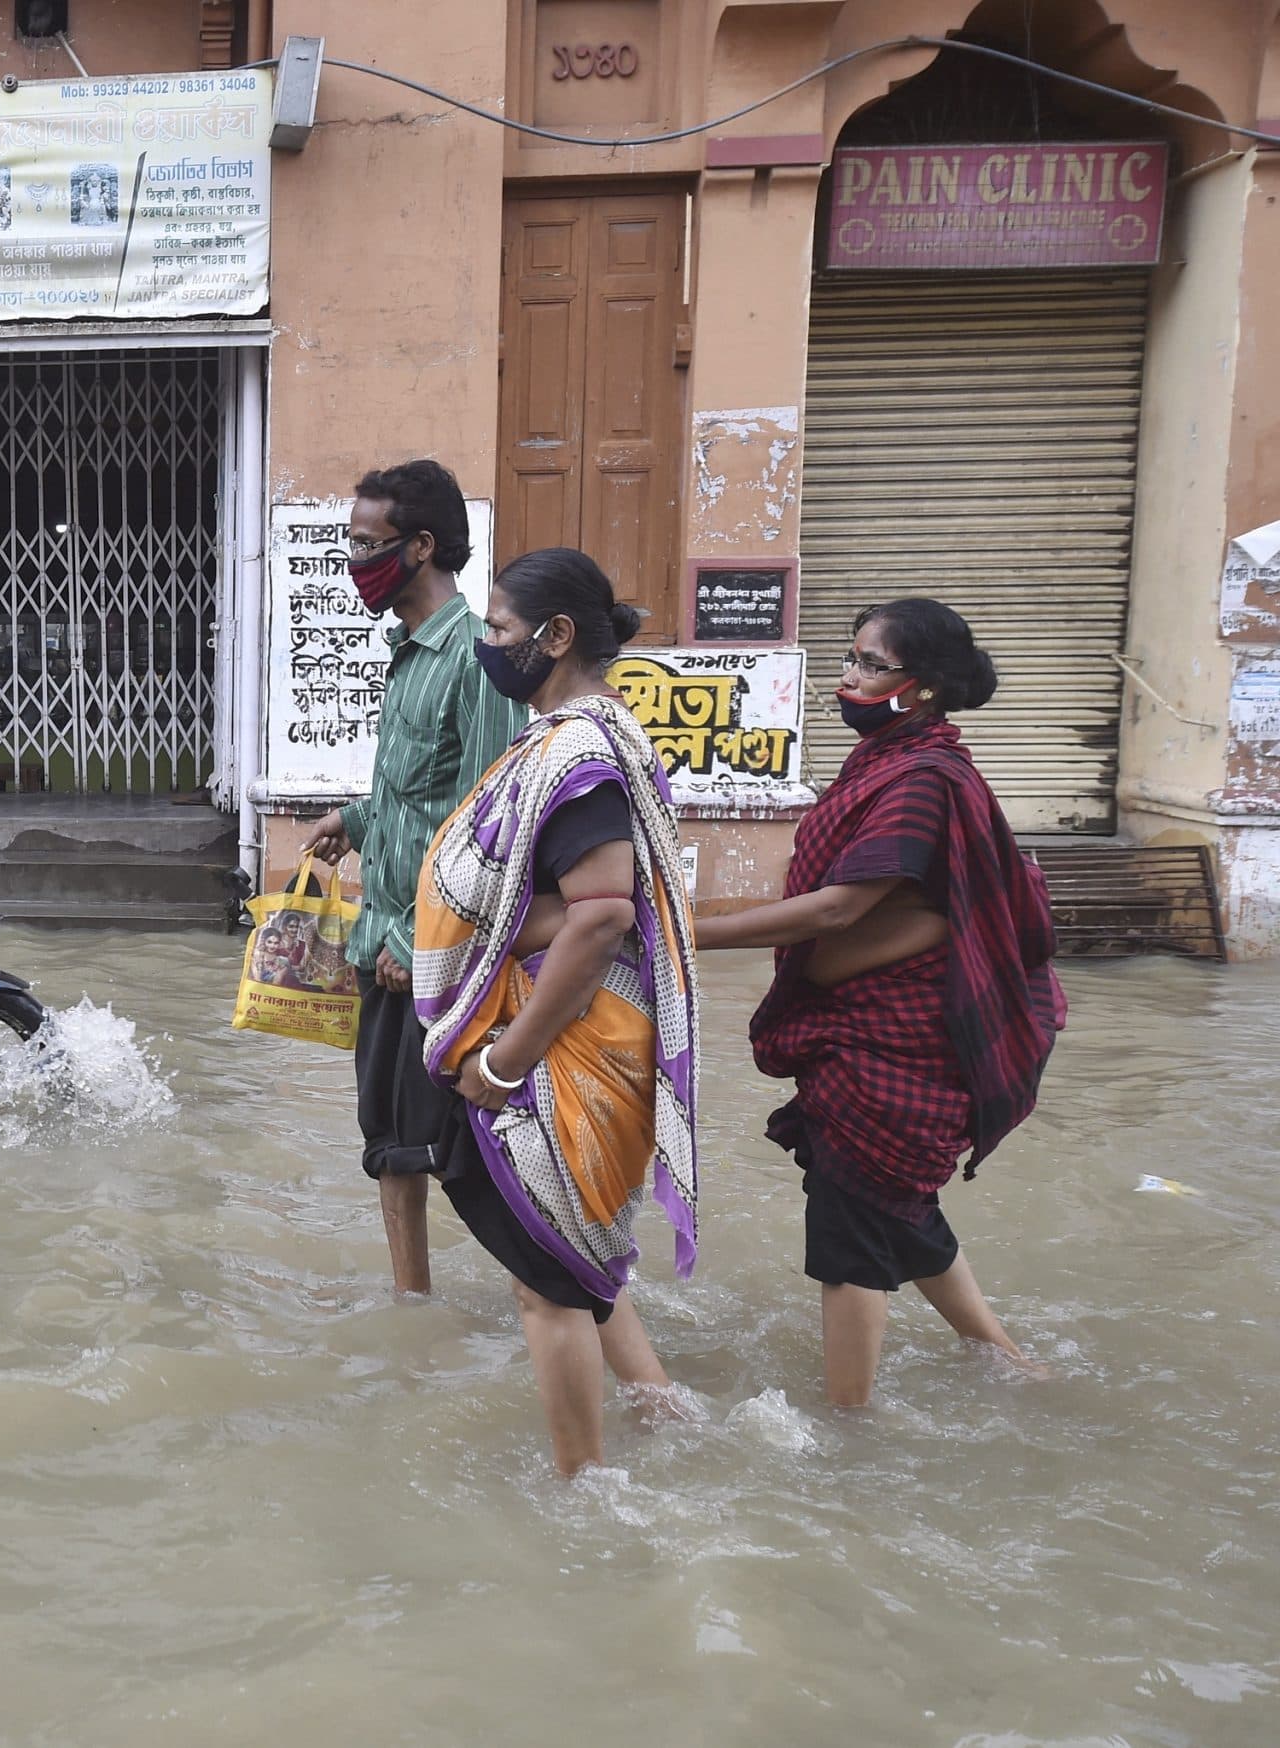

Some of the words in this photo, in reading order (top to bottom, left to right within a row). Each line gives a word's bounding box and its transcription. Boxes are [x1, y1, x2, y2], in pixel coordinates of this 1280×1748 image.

[61, 85, 89, 98] Mob:
[93, 82, 129, 97] 99329
[132, 80, 169, 95] 44202
[179, 79, 215, 93] 98361
[220, 77, 256, 91] 34048
[212, 156, 253, 179] বিভাগ
[838, 155, 961, 205] PAIN
[978, 152, 1153, 203] CLINIC
[135, 275, 188, 287] TANTRA,
[191, 273, 249, 286] MANTRA,
[181, 289, 255, 301] SPECIALIST
[288, 548, 351, 578] ফ্যাসি
[698, 585, 710, 598] শ্রী
